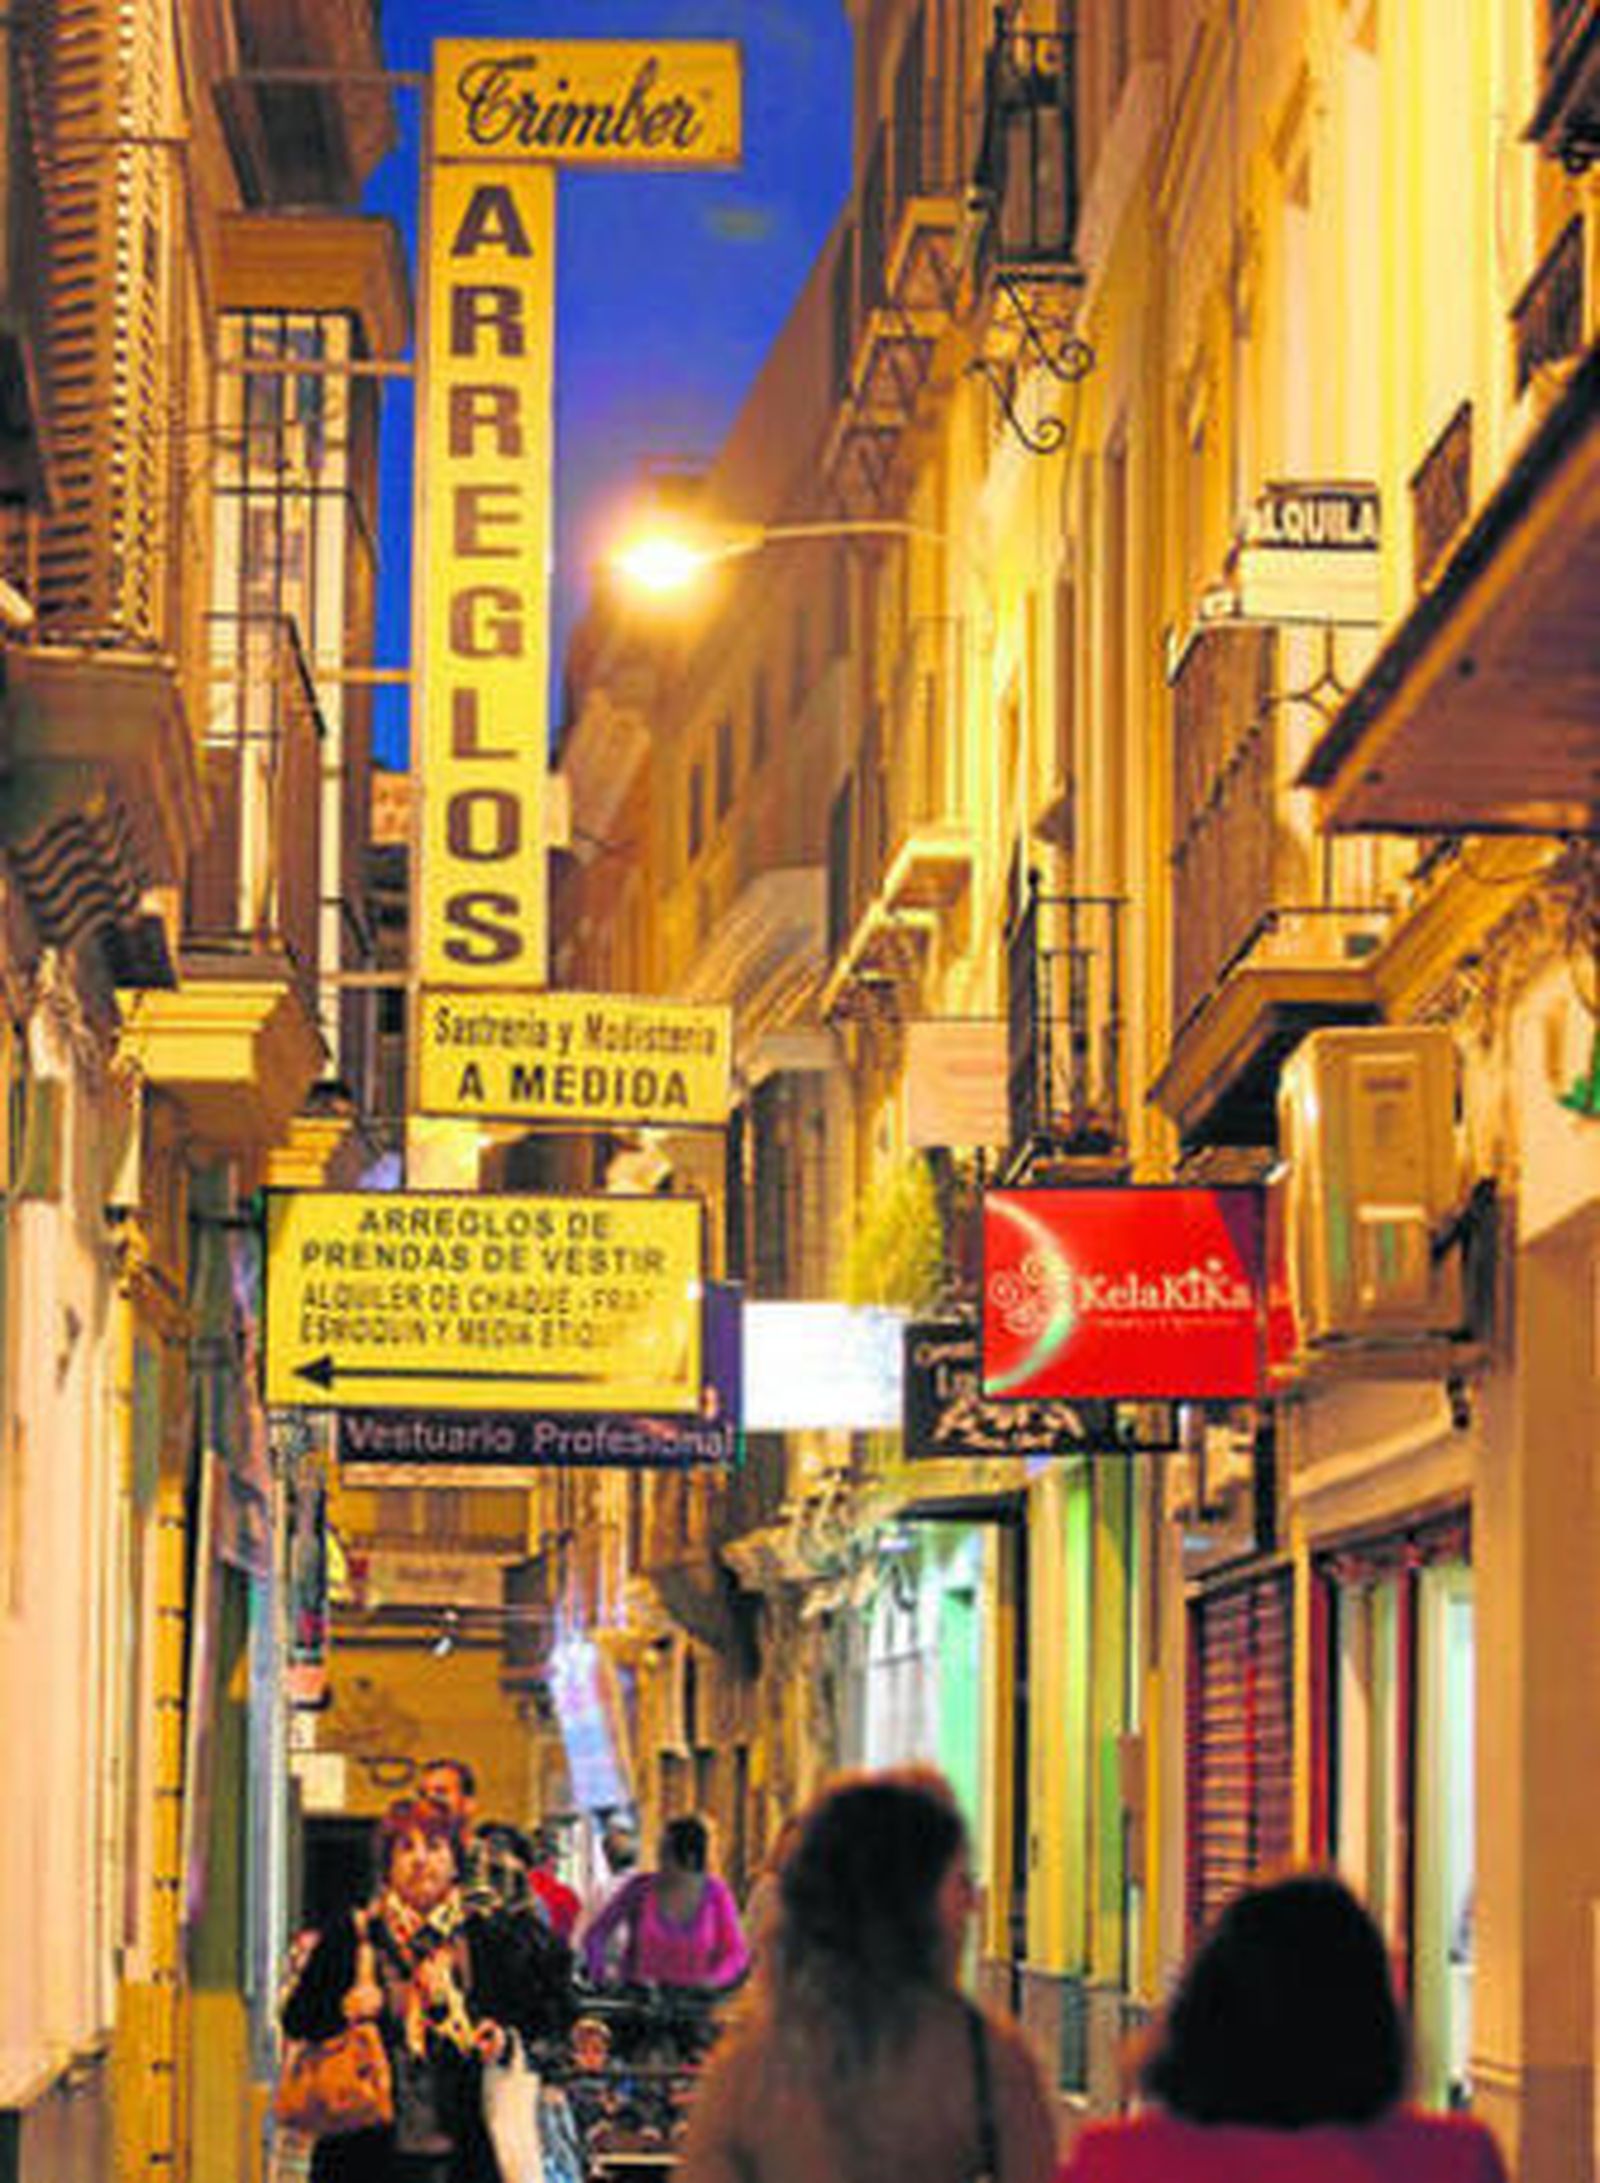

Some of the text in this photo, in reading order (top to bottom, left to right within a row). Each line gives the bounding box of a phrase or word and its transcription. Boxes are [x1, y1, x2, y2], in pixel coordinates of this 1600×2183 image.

[457, 55, 702, 148] Trimber
[443, 183, 534, 967] ARREGLOS
[557, 1020, 573, 1056] y
[457, 1060, 690, 1109] A MEDIDA
[358, 1207, 614, 1241] ARREGLOS DE
[301, 1241, 666, 1276] PRENDAS DE VESTIR
[302, 1282, 422, 1312] ALQUILER
[429, 1284, 461, 1312] DE
[435, 1317, 450, 1342] Y
[346, 1417, 736, 1459] Vestuario Profesional
